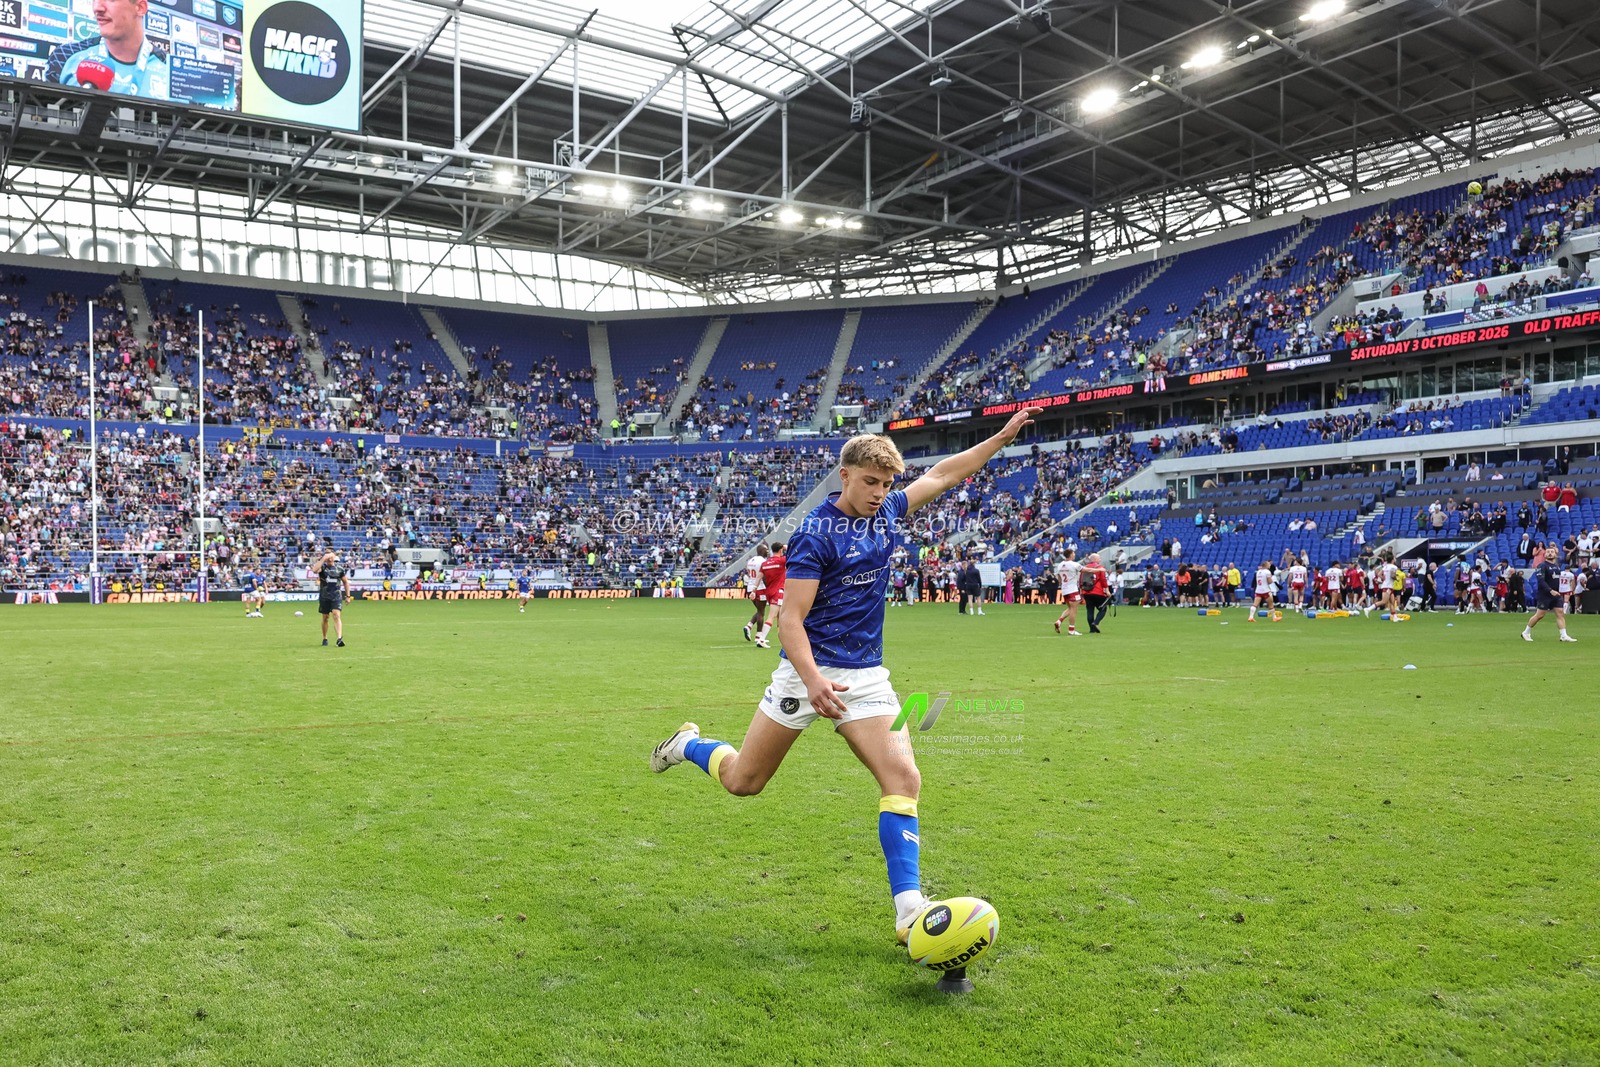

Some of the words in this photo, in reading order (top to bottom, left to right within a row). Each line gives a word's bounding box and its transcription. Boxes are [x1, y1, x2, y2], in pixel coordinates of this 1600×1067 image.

[28, 14, 67, 29] BETFRED
[0, 38, 35, 51] ETFRED
[264, 27, 338, 59] MAGIC
[263, 47, 337, 79] WKND
[1350, 340, 1411, 360] SATURDAY
[1411, 339, 1419, 352] 3
[1421, 331, 1477, 350] OCTOBER
[1478, 325, 1510, 342] 2026
[1523, 319, 1551, 335] OLD
[1554, 309, 1600, 330] TRAFF
[1189, 370, 1222, 385] GRAND
[1220, 366, 1249, 381] FINAL
[983, 402, 1016, 416] SATURDAY
[1016, 402, 1021, 410] 3
[1021, 398, 1052, 410] OCTOBER
[1053, 394, 1070, 405] 2026
[1077, 392, 1092, 402] OLD
[1093, 385, 1133, 399] TRAFFORD
[854, 568, 882, 585] ASHB
[1062, 573, 1068, 583] 2
[107, 592, 163, 603] GRAND
[362, 591, 434, 601] SATURDAY
[436, 591, 443, 600] 3
[446, 590, 504, 600] OCTOBER
[548, 589, 572, 599] OLD
[926, 936, 989, 971] STEEDEN
